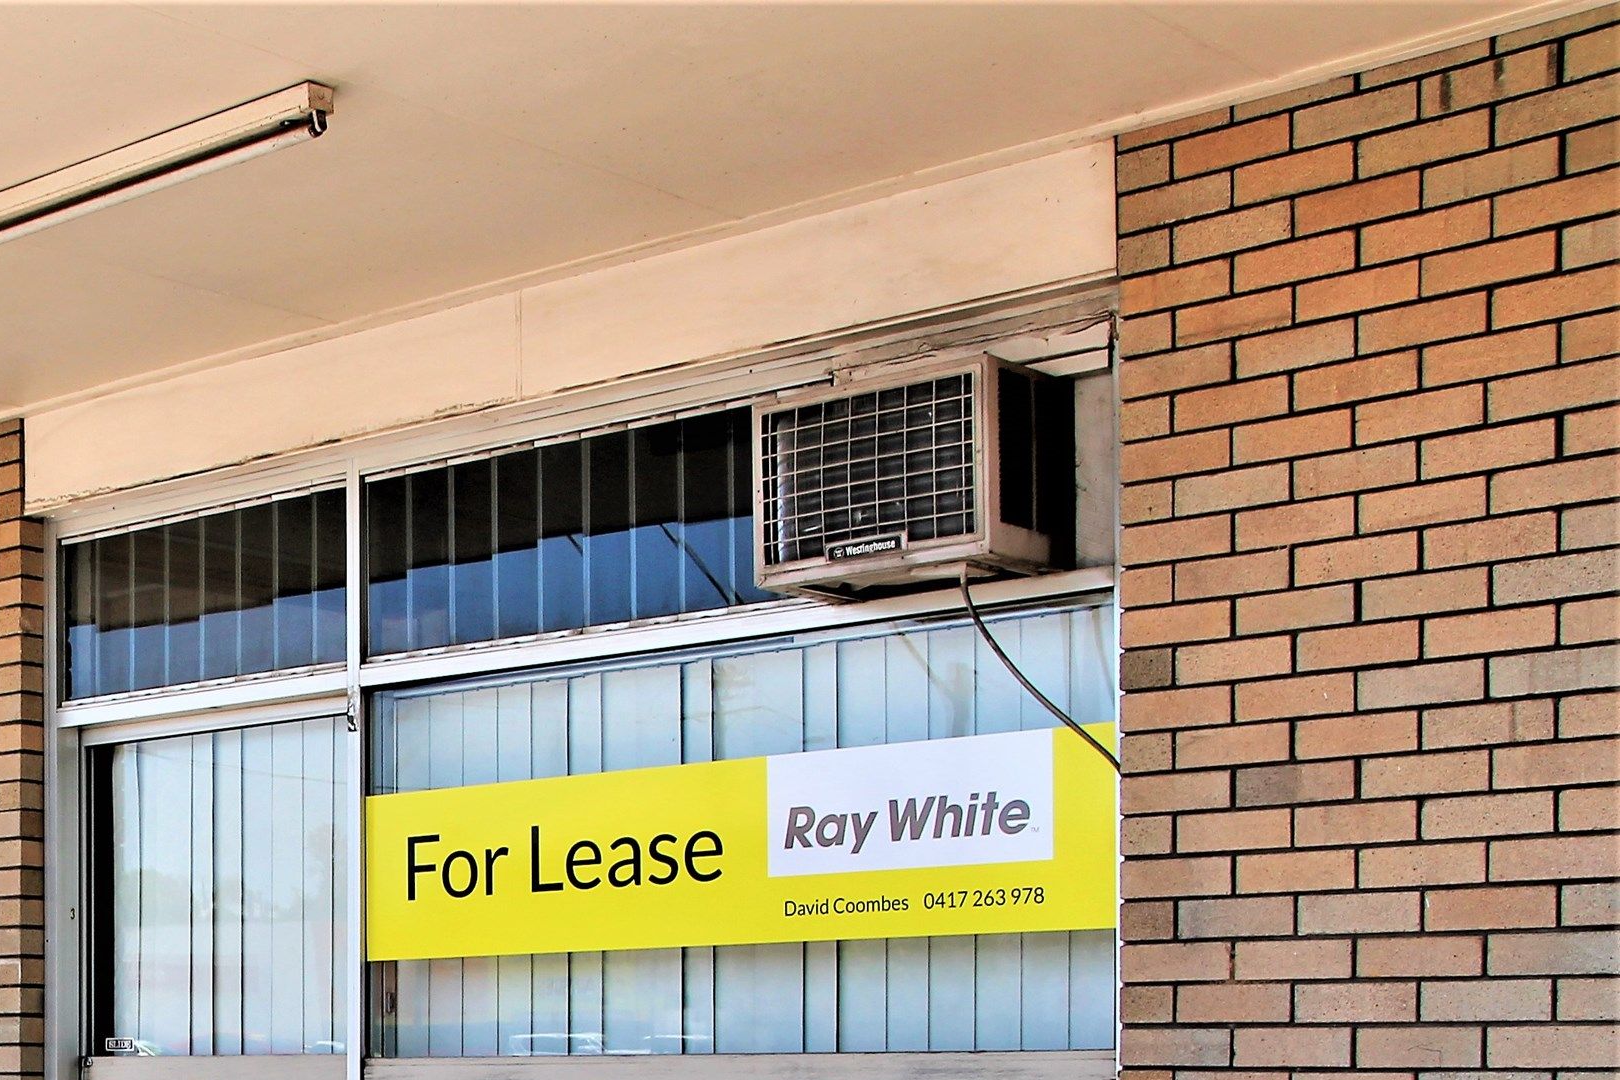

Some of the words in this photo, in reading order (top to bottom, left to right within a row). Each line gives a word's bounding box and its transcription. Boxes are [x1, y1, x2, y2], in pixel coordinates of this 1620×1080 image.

[845, 540, 896, 556] Westinghouse
[783, 806, 879, 855] Ray
[888, 791, 1031, 842] White
[406, 833, 509, 902] For
[530, 824, 725, 894] Lease
[784, 899, 829, 917] David
[833, 896, 909, 914] Coombes
[923, 891, 968, 910] 0417
[972, 889, 1007, 907] 263
[1011, 887, 1046, 905] 978
